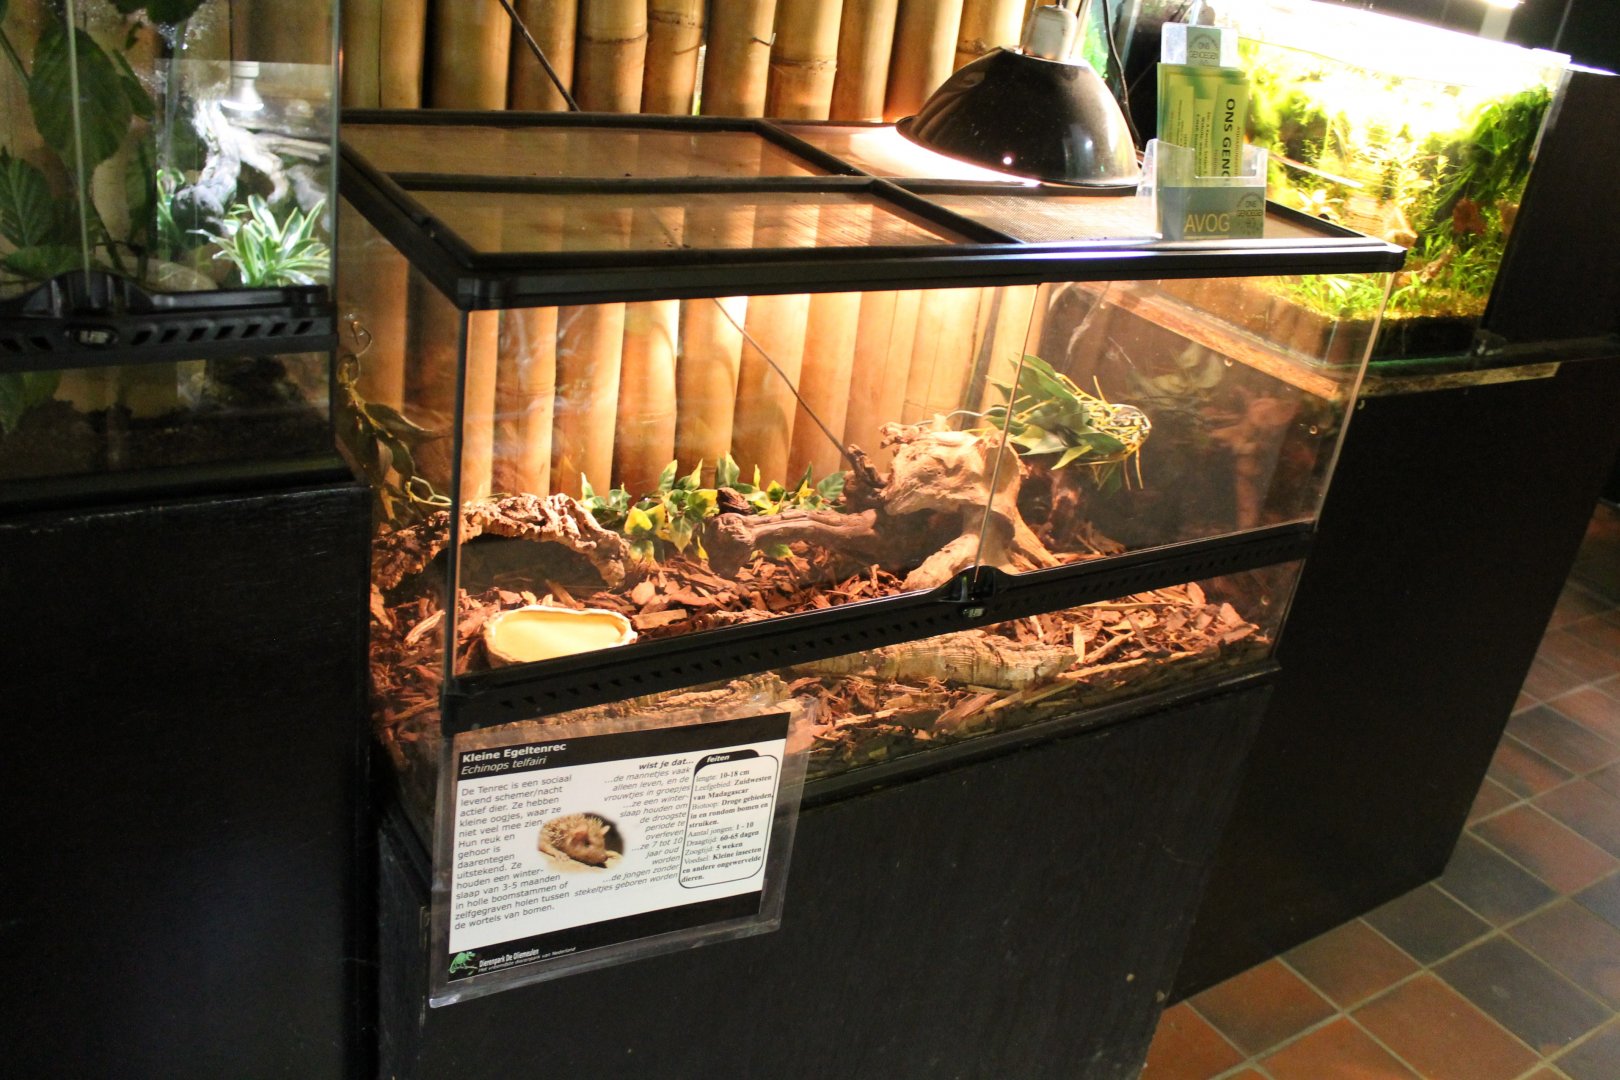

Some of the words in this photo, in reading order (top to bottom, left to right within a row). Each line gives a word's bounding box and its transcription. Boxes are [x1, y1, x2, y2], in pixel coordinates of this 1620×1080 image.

[1224, 98, 1236, 132] ONS
[1184, 213, 1230, 232] AVOG
[463, 751, 500, 763] Kleine
[503, 743, 566, 758] Egeltenrec
[461, 762, 509, 775] Echinops
[512, 756, 547, 768] telfairi
[626, 770, 669, 780] mannetjes
[720, 770, 738, 779] 10-18
[734, 775, 772, 785] Zuidwesten
[462, 788, 474, 796] De
[478, 784, 508, 794] Tenrec
[542, 774, 572, 785] sociaal
[612, 782, 637, 791] alleen
[708, 788, 749, 798] Madagascar
[461, 796, 492, 807] levend
[495, 786, 563, 802] schemer/nacht
[603, 791, 644, 802] vrouwtjes
[656, 785, 690, 796] groepjes
[721, 797, 741, 806] Droge
[460, 806, 487, 818] actief
[489, 803, 508, 813] dier.
[512, 801, 523, 810] Ze
[527, 797, 559, 807] hebben
[620, 810, 641, 818] slaap
[643, 805, 673, 814] houden
[709, 808, 735, 816] rondom
[737, 804, 759, 812] bomen
[459, 815, 487, 827] kleine
[491, 812, 523, 824] oogjes,
[527, 807, 548, 817] waar
[652, 812, 686, 821] droogste
[689, 819, 719, 828] struiken.
[459, 828, 477, 838] niet
[480, 825, 499, 835] veel
[502, 822, 521, 831] mee
[524, 818, 544, 827] zien.
[645, 821, 675, 832] periode
[646, 829, 684, 840] overleven
[740, 830, 759, 838] dagen
[458, 837, 477, 848] Hun
[481, 834, 500, 844] reuk
[504, 833, 515, 841] en
[457, 853, 515, 869] daarentegen
[458, 848, 490, 860] gehoor
[645, 850, 661, 859] jaar
[652, 855, 680, 865] worden
[712, 851, 734, 860] Kleine
[736, 847, 762, 856] insecten
[457, 865, 507, 879] uitstekend.
[511, 861, 522, 870] Ze
[692, 864, 716, 872] andere
[717, 855, 761, 868] ongewervelde
[456, 878, 491, 890] houden
[493, 874, 509, 883] een
[513, 868, 544, 880] winter-
[622, 869, 650, 880] jongen
[653, 864, 680, 873] zonder
[456, 888, 480, 900] slaap
[483, 885, 499, 895] van
[502, 881, 518, 891] 3-5
[520, 874, 560, 886] maanden
[574, 884, 613, 896] stekeltjes
[615, 878, 647, 890] geboren
[650, 872, 678, 882] worden
[467, 897, 488, 908] holle
[492, 885, 556, 903] boomstammen
[559, 881, 569, 890] of
[455, 903, 512, 920] zelfgegraven
[515, 897, 539, 908] holen
[542, 891, 570, 902] tussen
[454, 922, 466, 930] de
[469, 914, 501, 927] wortels
[504, 910, 520, 920] van
[522, 904, 555, 916] bomen.
